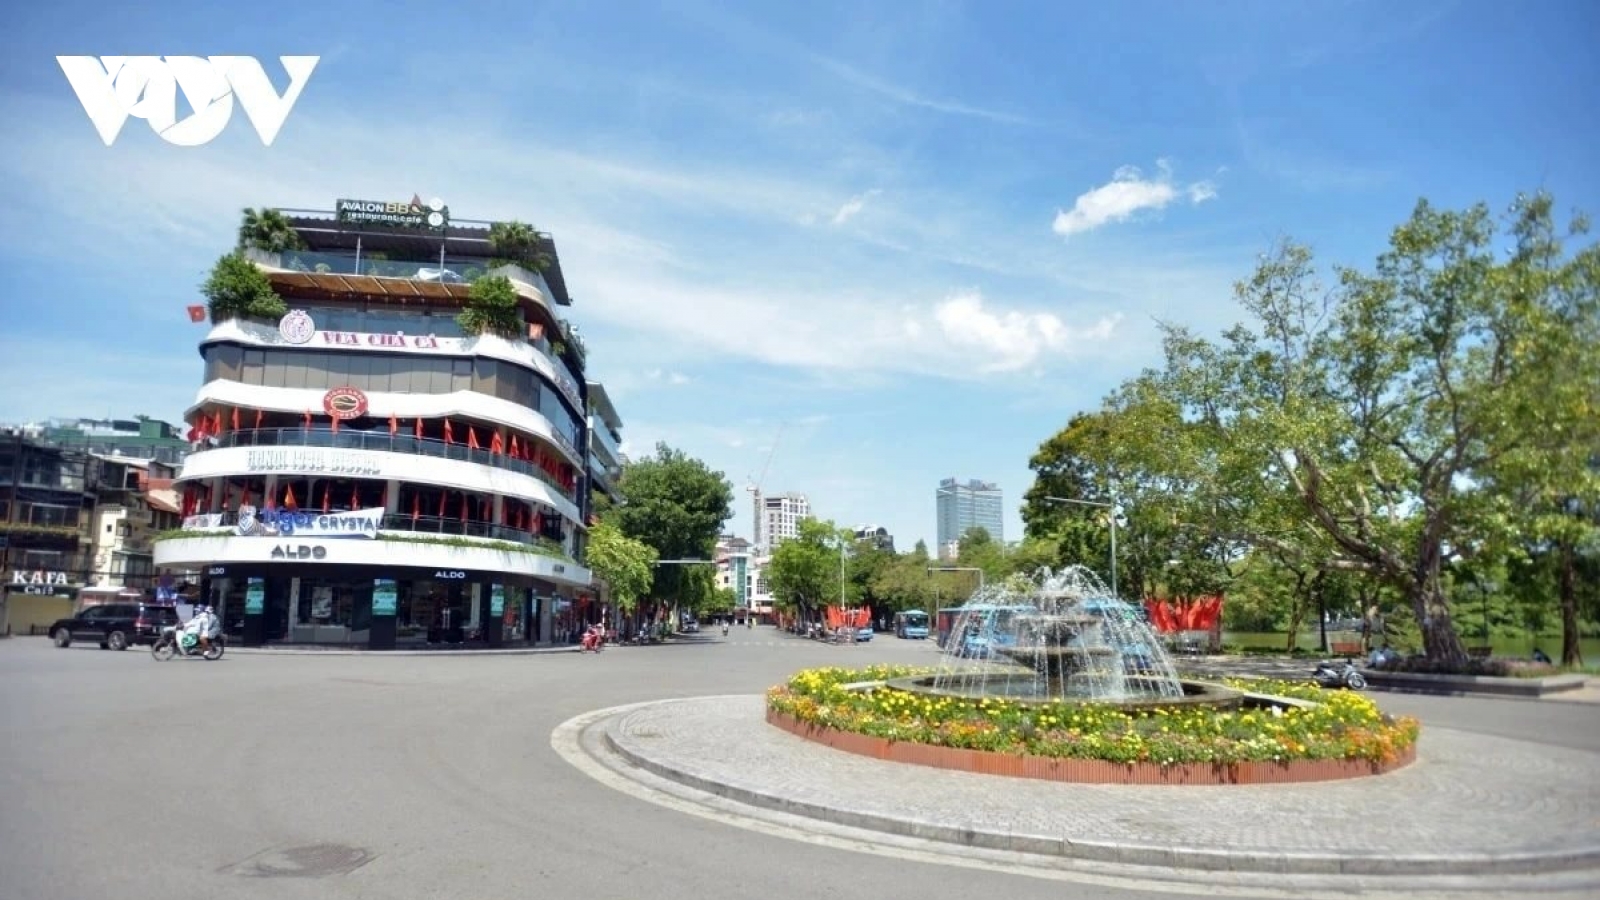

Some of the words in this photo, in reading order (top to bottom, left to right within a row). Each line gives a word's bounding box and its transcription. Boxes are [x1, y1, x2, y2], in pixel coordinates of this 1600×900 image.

[341, 202, 384, 213] AVALON
[323, 331, 359, 345] VUA
[271, 545, 327, 559] ALDO
[12, 570, 68, 585] KAFA
[435, 571, 466, 579] ALDO
